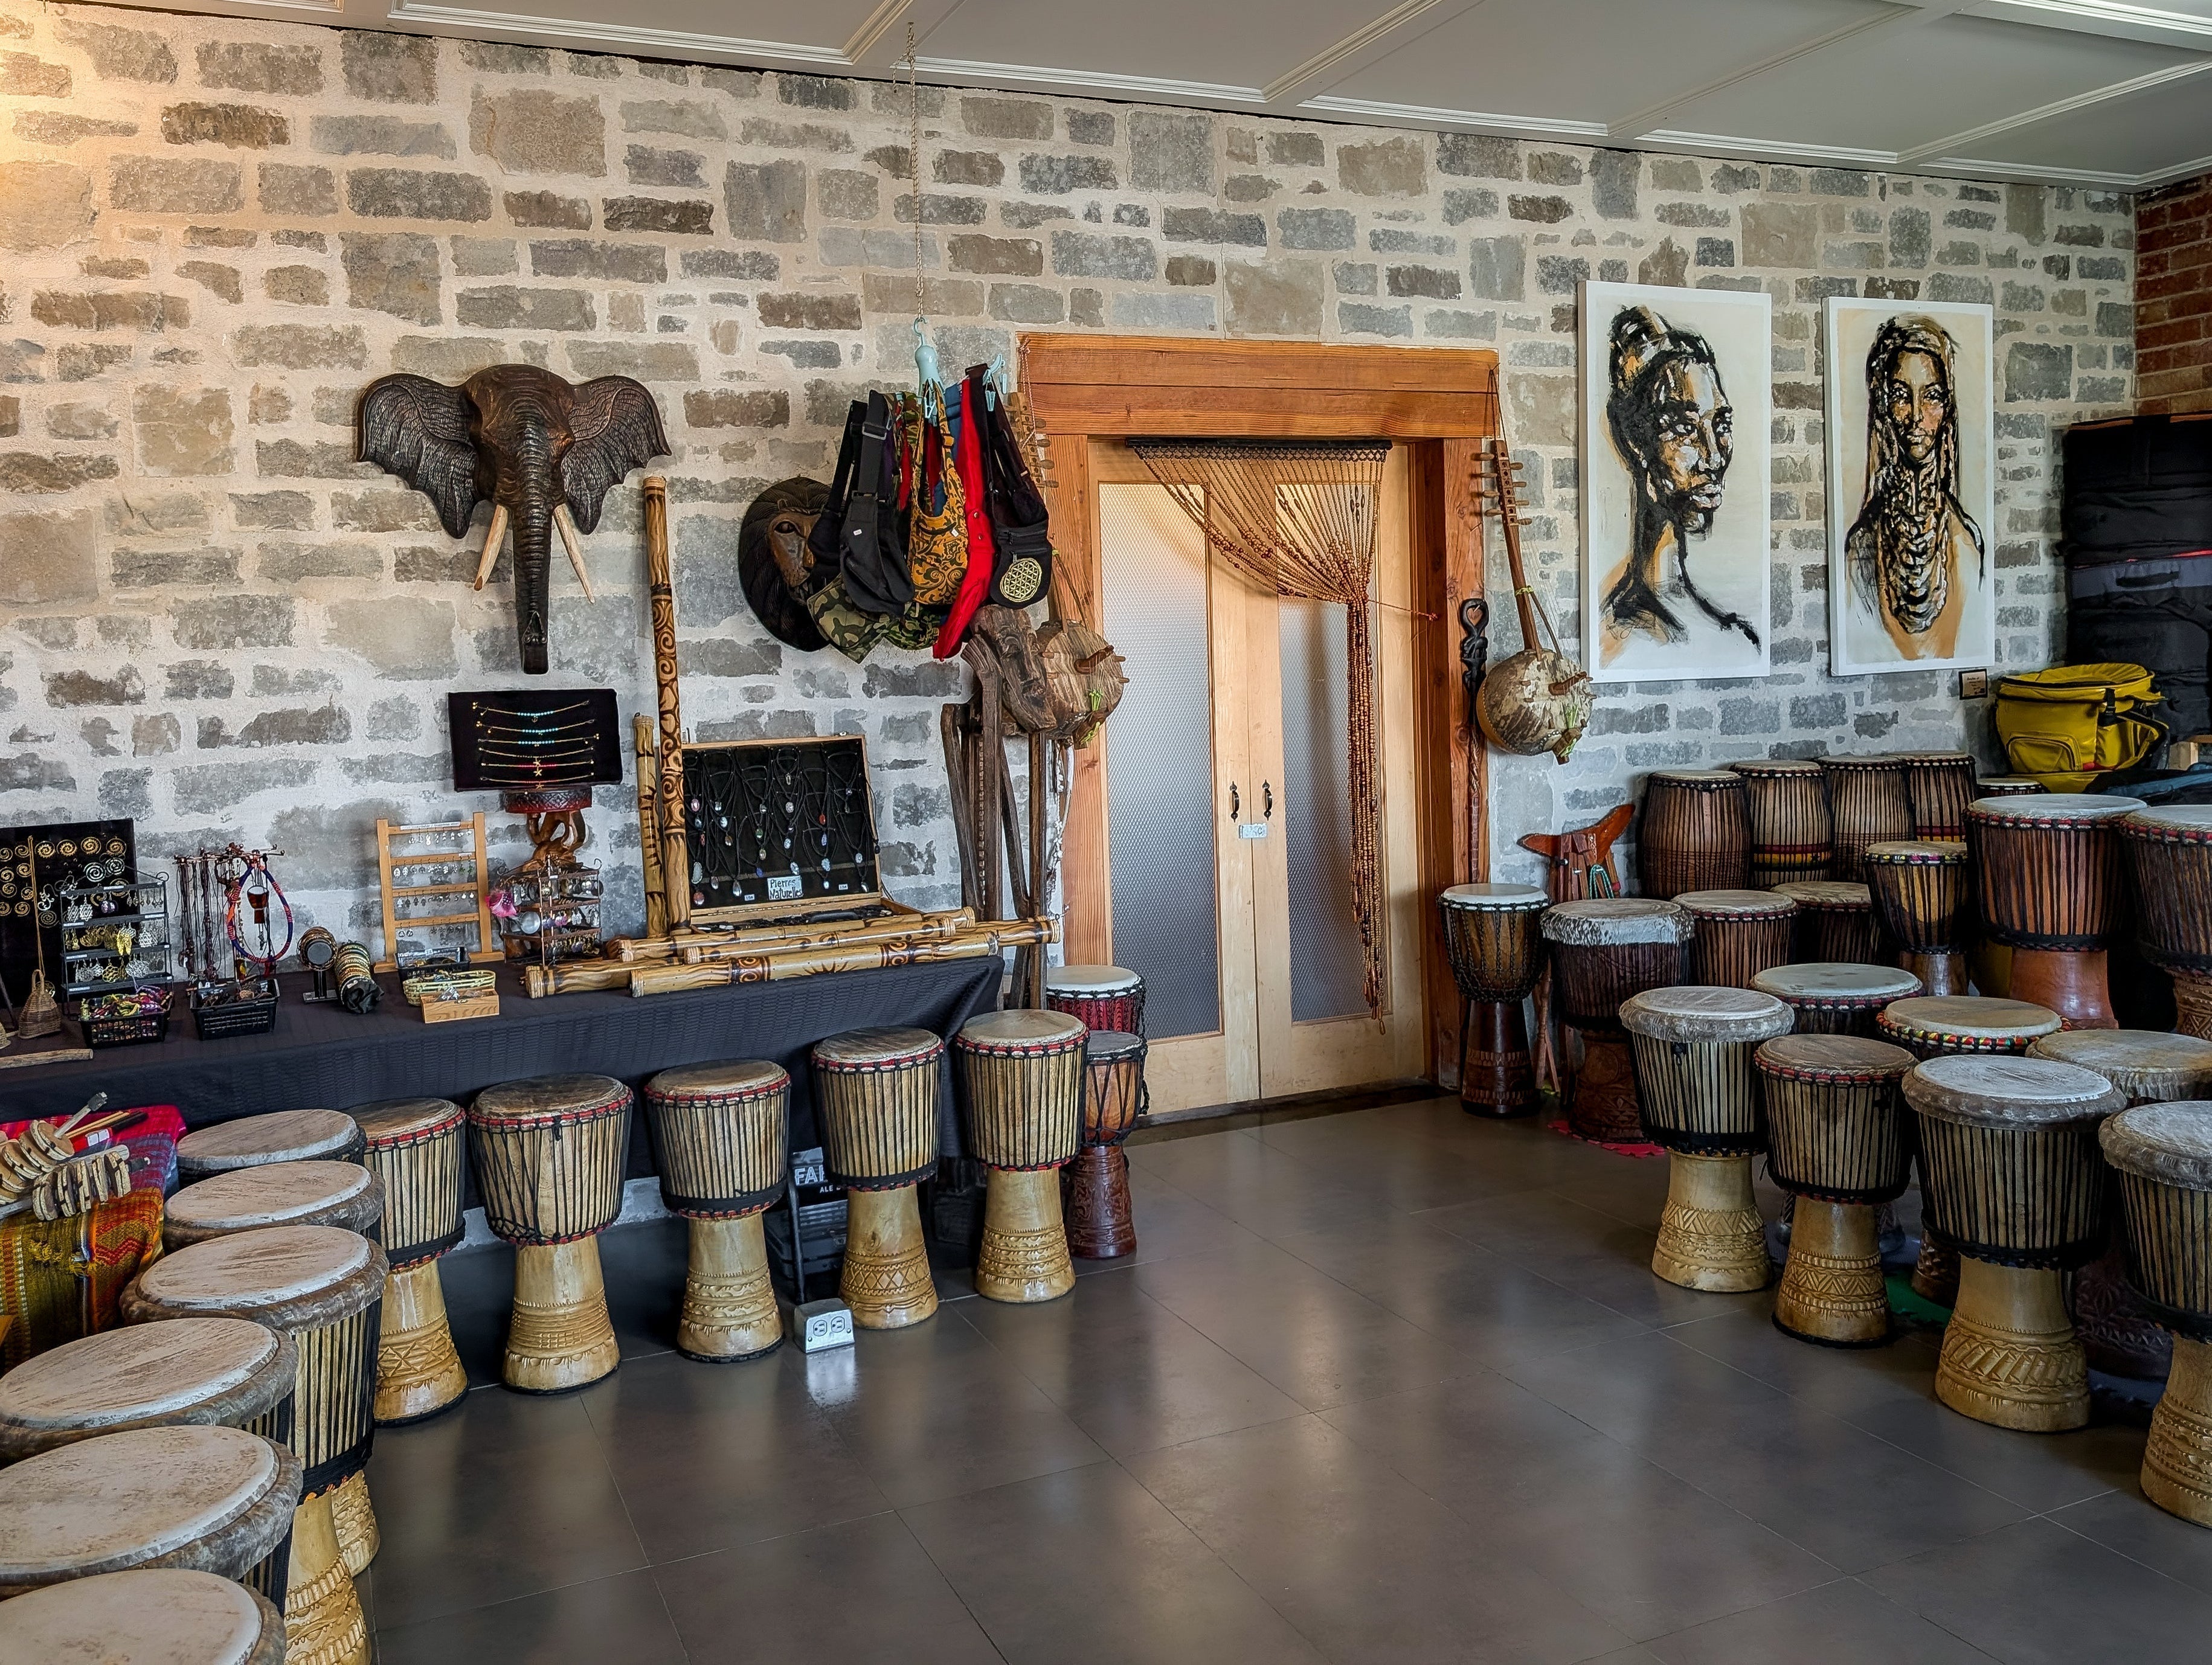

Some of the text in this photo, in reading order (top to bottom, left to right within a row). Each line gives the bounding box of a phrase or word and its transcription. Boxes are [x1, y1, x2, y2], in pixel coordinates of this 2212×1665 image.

[770, 879, 796, 888] Pierres
[770, 887, 802, 899] Naturelles
[820, 1185, 833, 1193] ALE
